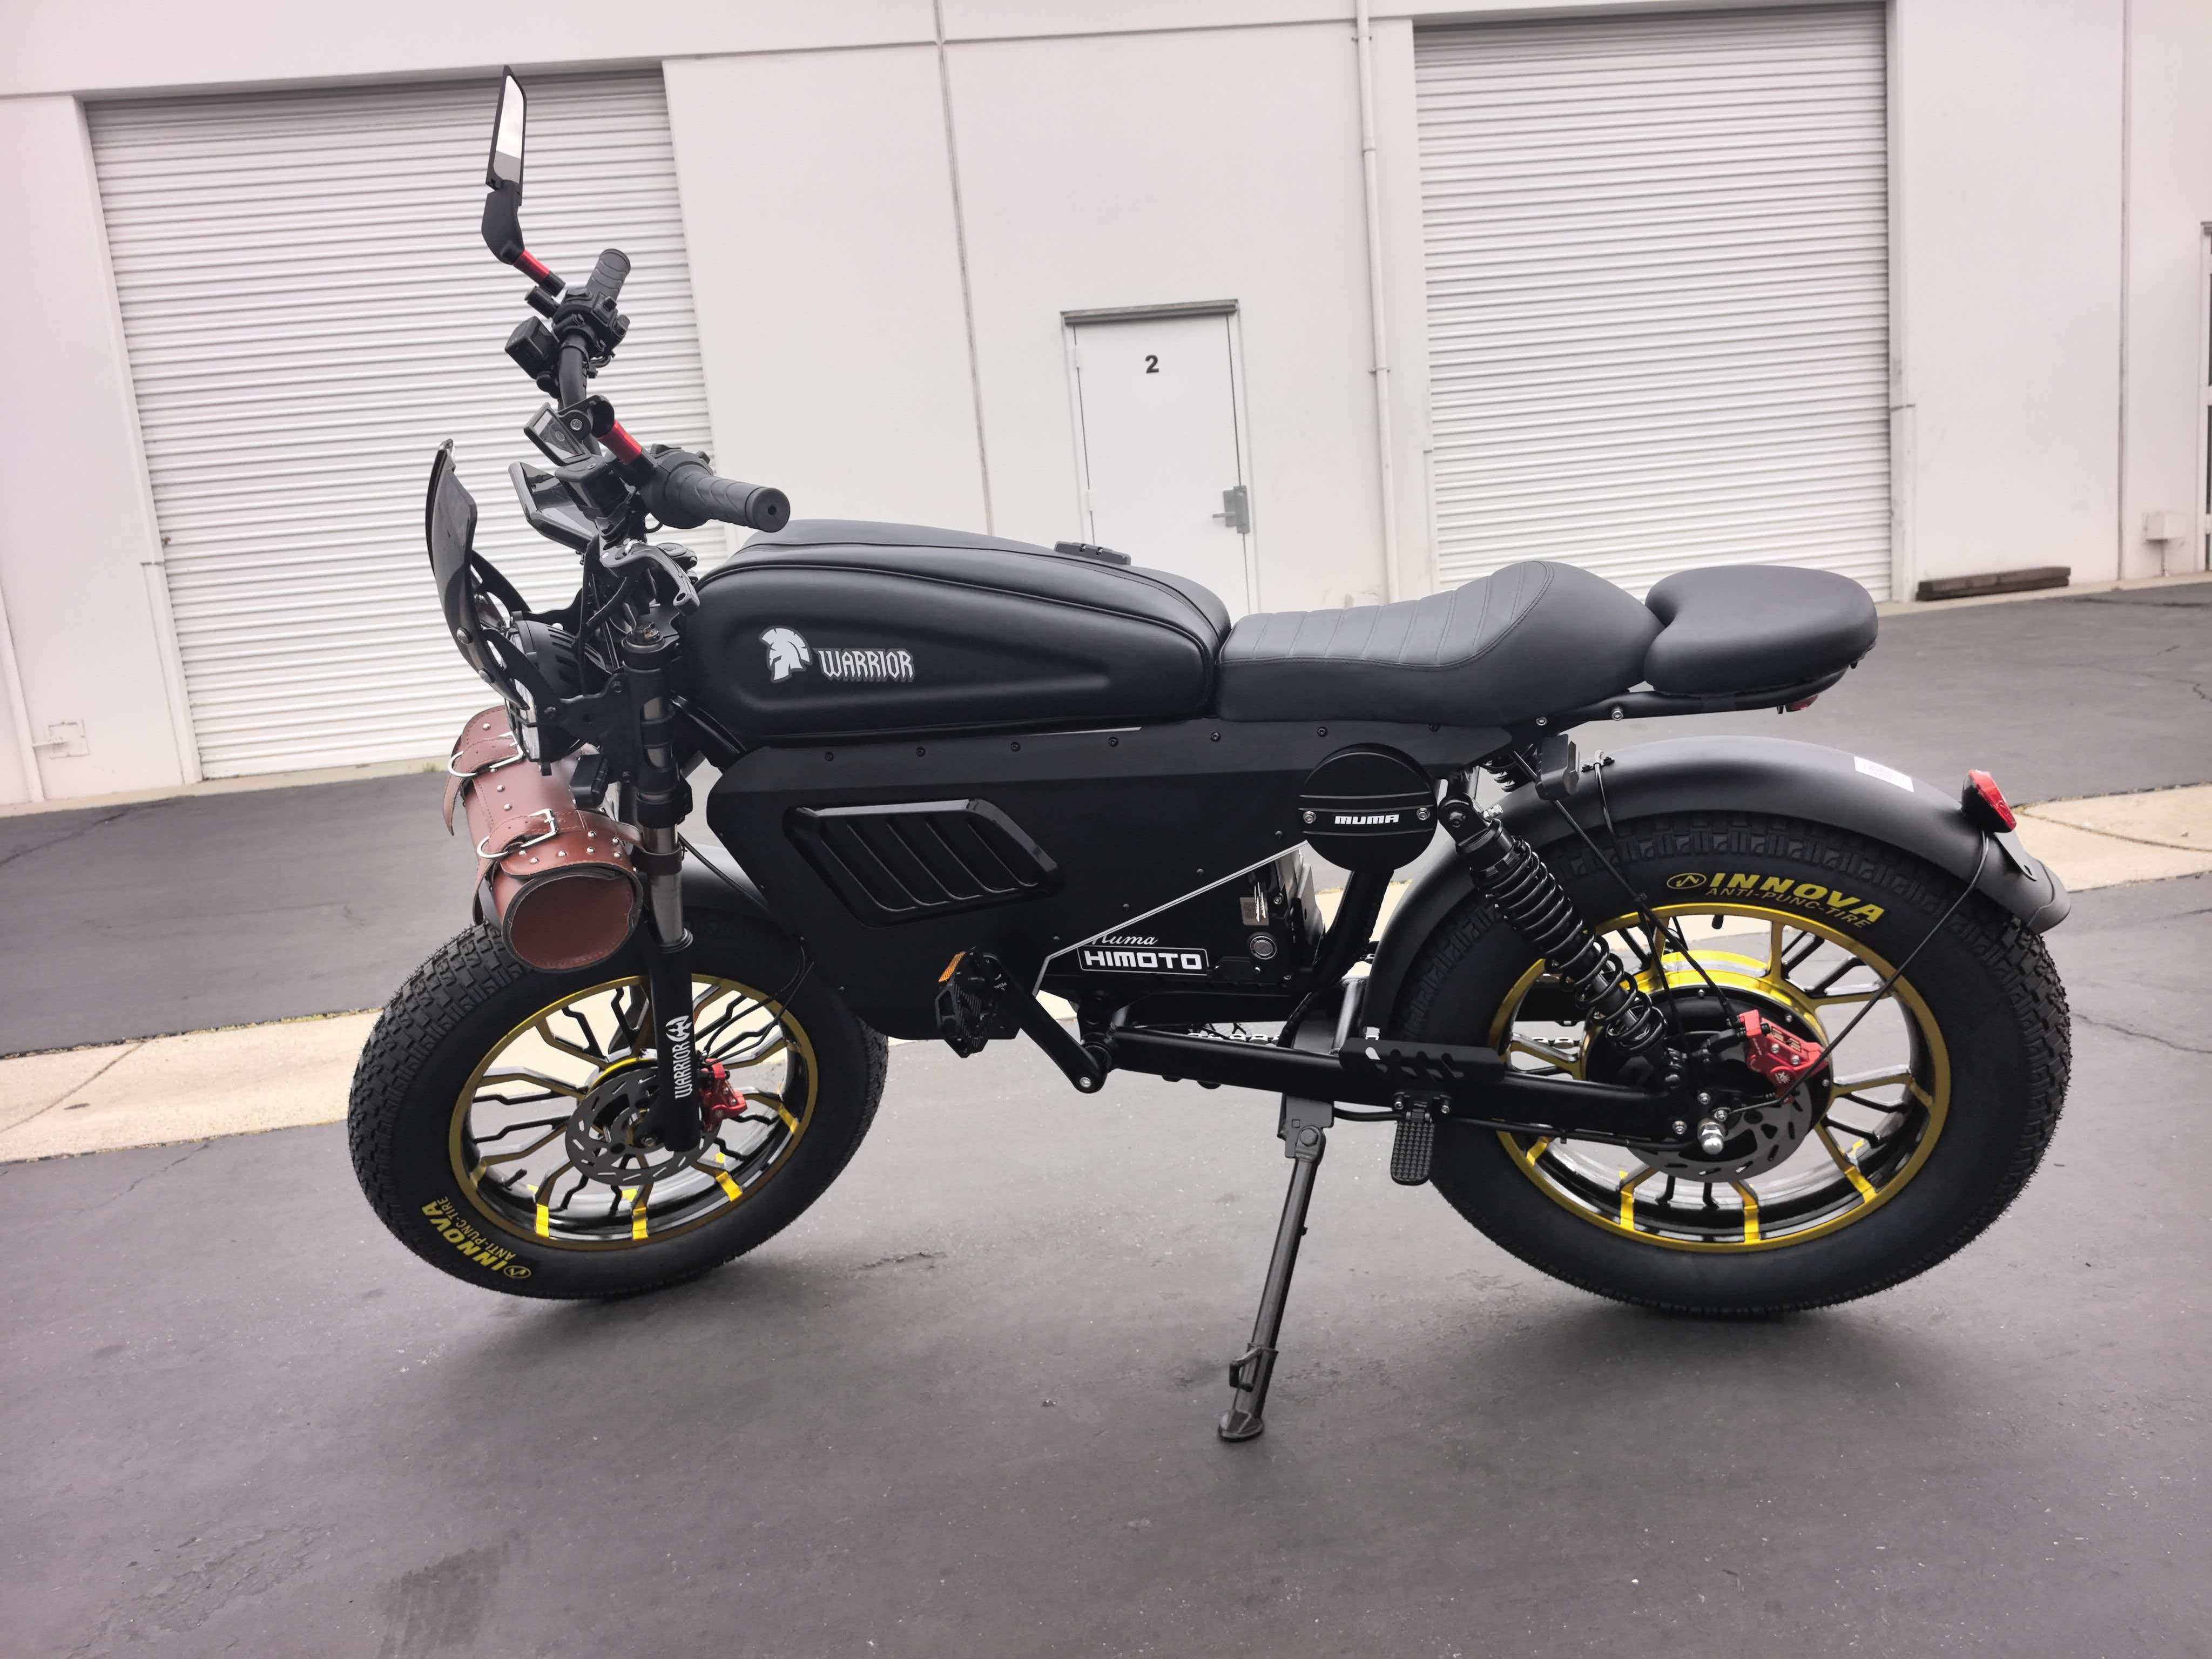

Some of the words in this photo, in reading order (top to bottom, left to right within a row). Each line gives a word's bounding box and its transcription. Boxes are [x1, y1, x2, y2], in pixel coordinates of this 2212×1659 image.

[1145, 354, 1159, 374] 2
[817, 650, 914, 679] WARRIOR
[1334, 814, 1400, 825] MUMA
[1705, 887, 1872, 929] ANTI-PUNC-TIRE
[1709, 872, 1885, 923] INNOVA
[1083, 950, 1202, 970] HIMOTO
[672, 1041, 693, 1100] WARRIOR
[422, 1201, 508, 1271] INNOVA
[437, 1196, 516, 1260] ANTI-PUNC-TIRE
